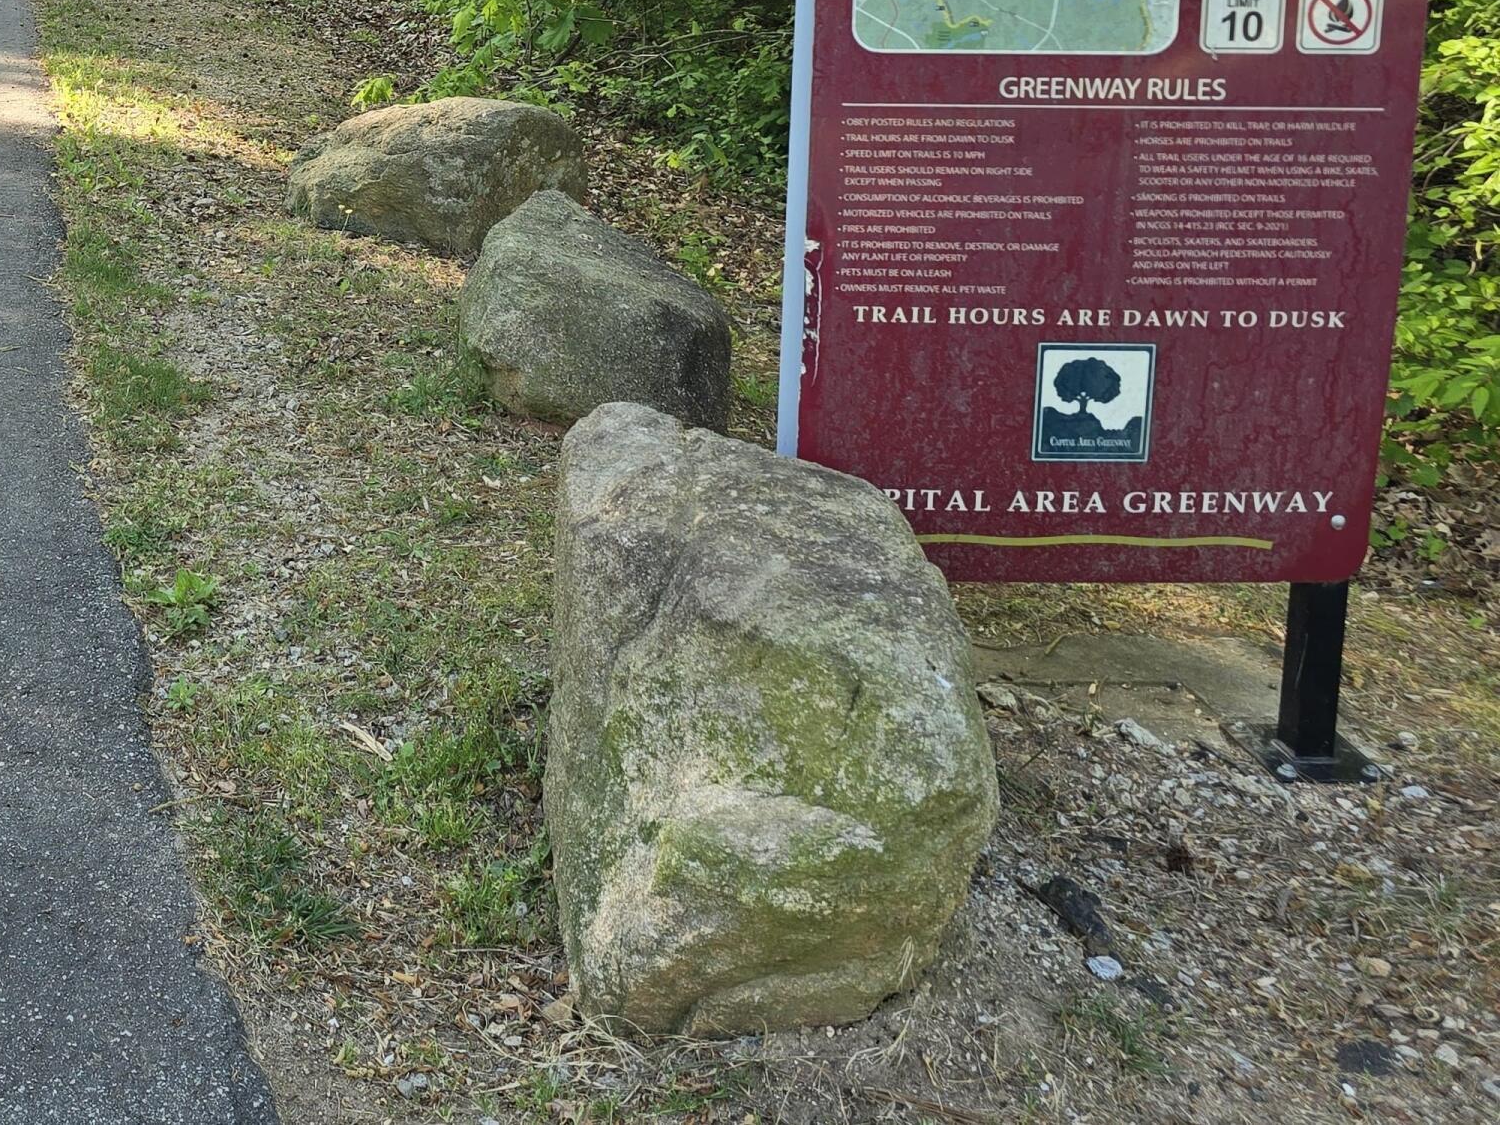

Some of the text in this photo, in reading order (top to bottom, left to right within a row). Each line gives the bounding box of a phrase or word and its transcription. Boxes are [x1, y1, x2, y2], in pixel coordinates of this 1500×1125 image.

[1221, 10, 1263, 42] 10
[999, 76, 1227, 101] GREENWAY RULES
[846, 118, 1016, 128] OBEY POSTED RULES AND REGULATIONS
[1140, 121, 1149, 129] IT
[1151, 121, 1158, 129] IS
[1160, 121, 1212, 130] PROHIBITED
[1213, 122, 1224, 130] TO
[1272, 122, 1286, 130] OR
[1287, 122, 1314, 130] HARM
[1316, 123, 1357, 131] WILDLIFE
[846, 134, 869, 142] TRAIL
[871, 134, 901, 142] HOURS
[921, 135, 946, 143] FROM
[948, 135, 975, 143] DAWN
[977, 135, 989, 143] TO
[990, 136, 1015, 144] DUSK
[1140, 137, 1293, 146] HORSES ARE PROHIBITED ON TRAILS
[845, 150, 985, 159] SPEED LIMIT ON TRAILS IS 10 MPH
[1140, 153, 1373, 164] ALL TRAIL USERS UNDER THE AGE OF ARE REQUIRED
[844, 165, 1033, 176] TRAIL USERS SHOULD REMAIN ON RIGHT SIDE
[844, 177, 942, 186] EXCEPT WHEN PASSING
[1139, 177, 1179, 186] SCOOTER
[1180, 178, 1193, 186] OR
[1194, 178, 1213, 186] ANY
[1214, 178, 1244, 186] OTHER
[1321, 179, 1357, 187] VEHICLE
[843, 193, 1084, 204] CONSUMPTION OF ALCOHOLIC BEVERAGES IS PROHIBITED
[1137, 193, 1286, 203] SMOKING IS PROHIBITED ON TRAILS
[842, 209, 1052, 220] MOTORIZED VEHICLES ARE PROHIBITED ON TRAILS
[1134, 209, 1345, 219] WEAPONS PROHIBITED EXCEPT THOSE PERMITTED
[842, 225, 936, 234] FIRES ARE PROHIBITED
[842, 240, 850, 248] IT
[851, 240, 859, 248] IS
[861, 241, 911, 249] PROHIBITED
[912, 241, 924, 249] TO
[1007, 243, 1020, 251] OR
[1021, 243, 1060, 252] DAMAGE
[842, 253, 968, 262] ANY PLANT LIFE OR PROPERTY
[1133, 249, 1170, 257] SHOULD
[1172, 249, 1219, 258] APPROACH
[1220, 249, 1277, 258] PEDESTRIANS
[1132, 261, 1229, 270] AND PASS ON THE LEFT
[841, 268, 861, 276] PETS
[863, 268, 888, 276] MUST
[901, 269, 915, 277] ON
[916, 269, 923, 277] A
[925, 269, 952, 277] LEASH
[1131, 277, 1318, 286] CAMPING IS PROHIBITED WITHOUT A PERMIT
[840, 284, 1006, 294] OWNERS MUST REMOVE ALL PET WASTE
[853, 306, 1347, 329] TRAIL HOURS ARE DAWN TO DUSK
[882, 488, 1334, 514] PITAL AREA GREENWAY
